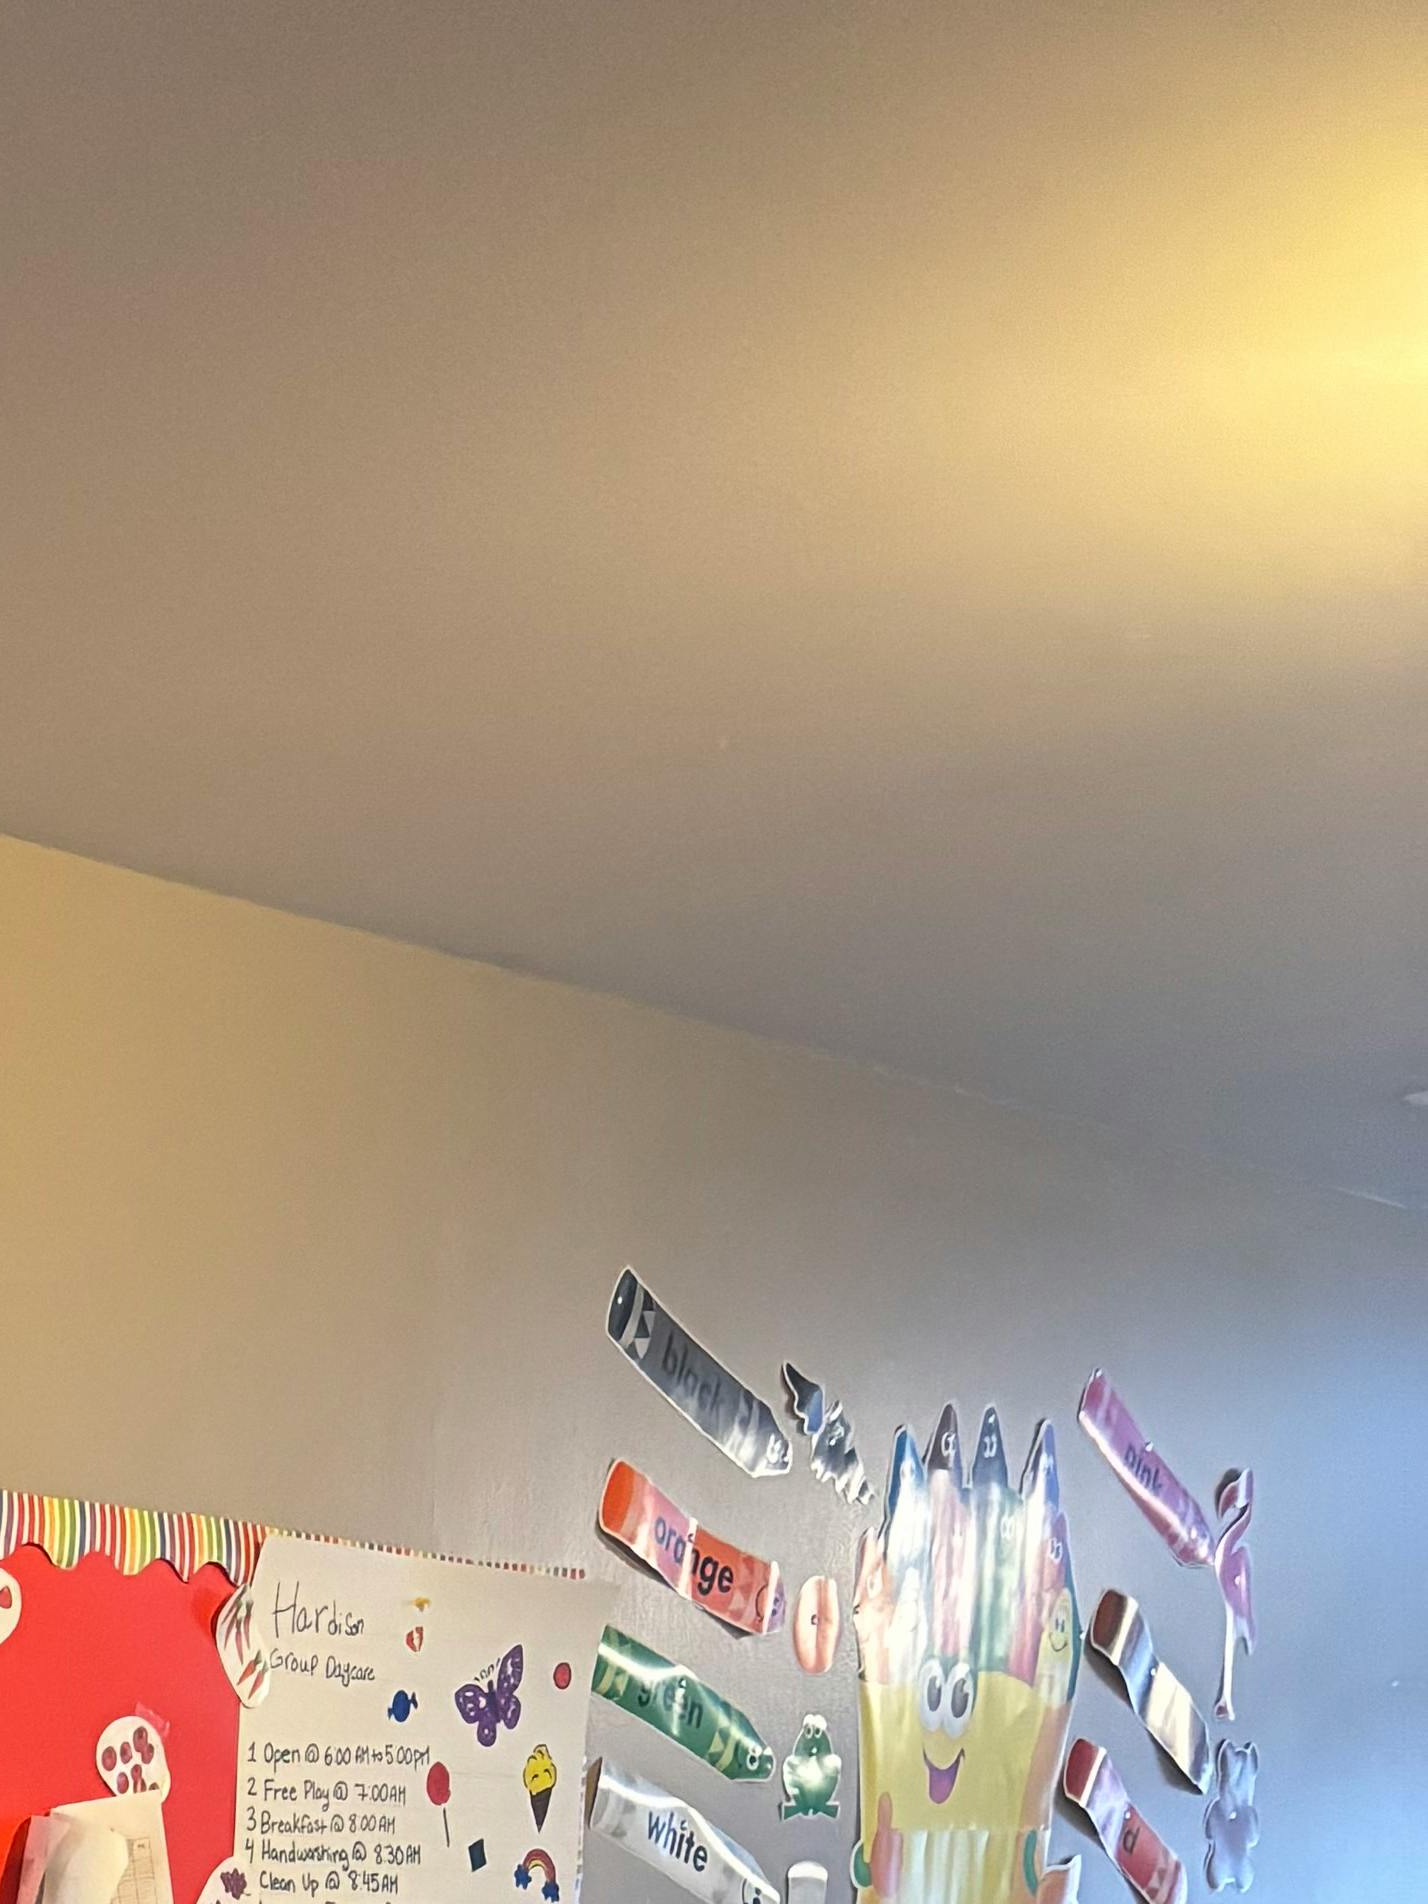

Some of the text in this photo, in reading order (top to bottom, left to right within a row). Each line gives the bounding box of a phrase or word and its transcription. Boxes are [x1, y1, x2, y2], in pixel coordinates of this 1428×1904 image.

[652, 1515, 735, 1596] orange
[271, 1580, 365, 1638] Hardison
[325, 1655, 376, 1687] Daycare
[247, 1741, 257, 1763] 1
[263, 1741, 301, 1773] Open
[304, 1743, 320, 1764] @
[247, 1777, 349, 1813] 2 Free Play @
[246, 1806, 345, 1836] 3 Breakfast @
[244, 1837, 368, 1873] 4 Handwashing @
[646, 1809, 709, 1873] white
[259, 1869, 341, 1898] Clean Up @
